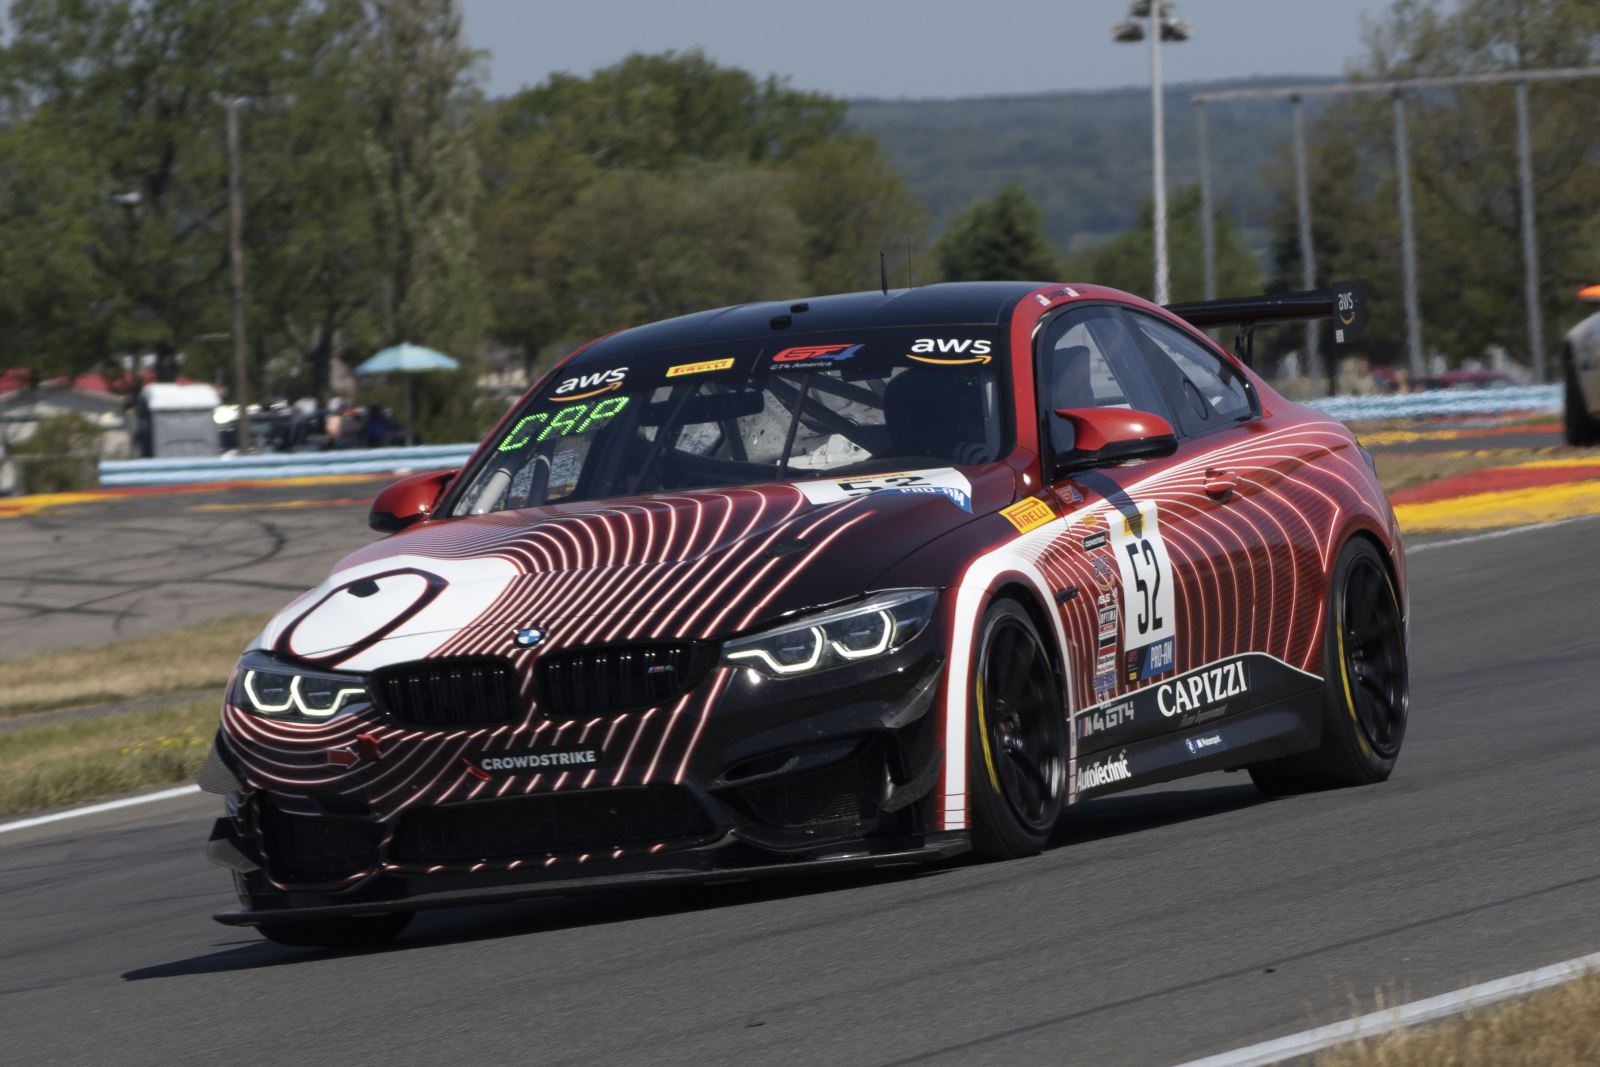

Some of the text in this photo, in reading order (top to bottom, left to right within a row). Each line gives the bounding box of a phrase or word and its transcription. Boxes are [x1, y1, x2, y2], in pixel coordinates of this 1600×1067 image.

[1338, 292, 1353, 311] aws
[772, 343, 865, 362] GT4
[911, 338, 991, 354] aws
[555, 367, 629, 394] aws
[498, 396, 630, 452] CAP
[838, 476, 931, 497] 52
[900, 486, 966, 507] PRO-AM
[1007, 499, 1049, 529] PIRELLI
[1126, 539, 1162, 635] 52
[1150, 640, 1173, 671] PRO-AM
[1157, 660, 1248, 718] CAPIZZI
[1105, 700, 1135, 729] GT4
[480, 750, 597, 772] CROWDSTRIKE
[1076, 753, 1132, 793] AutoTechnic
